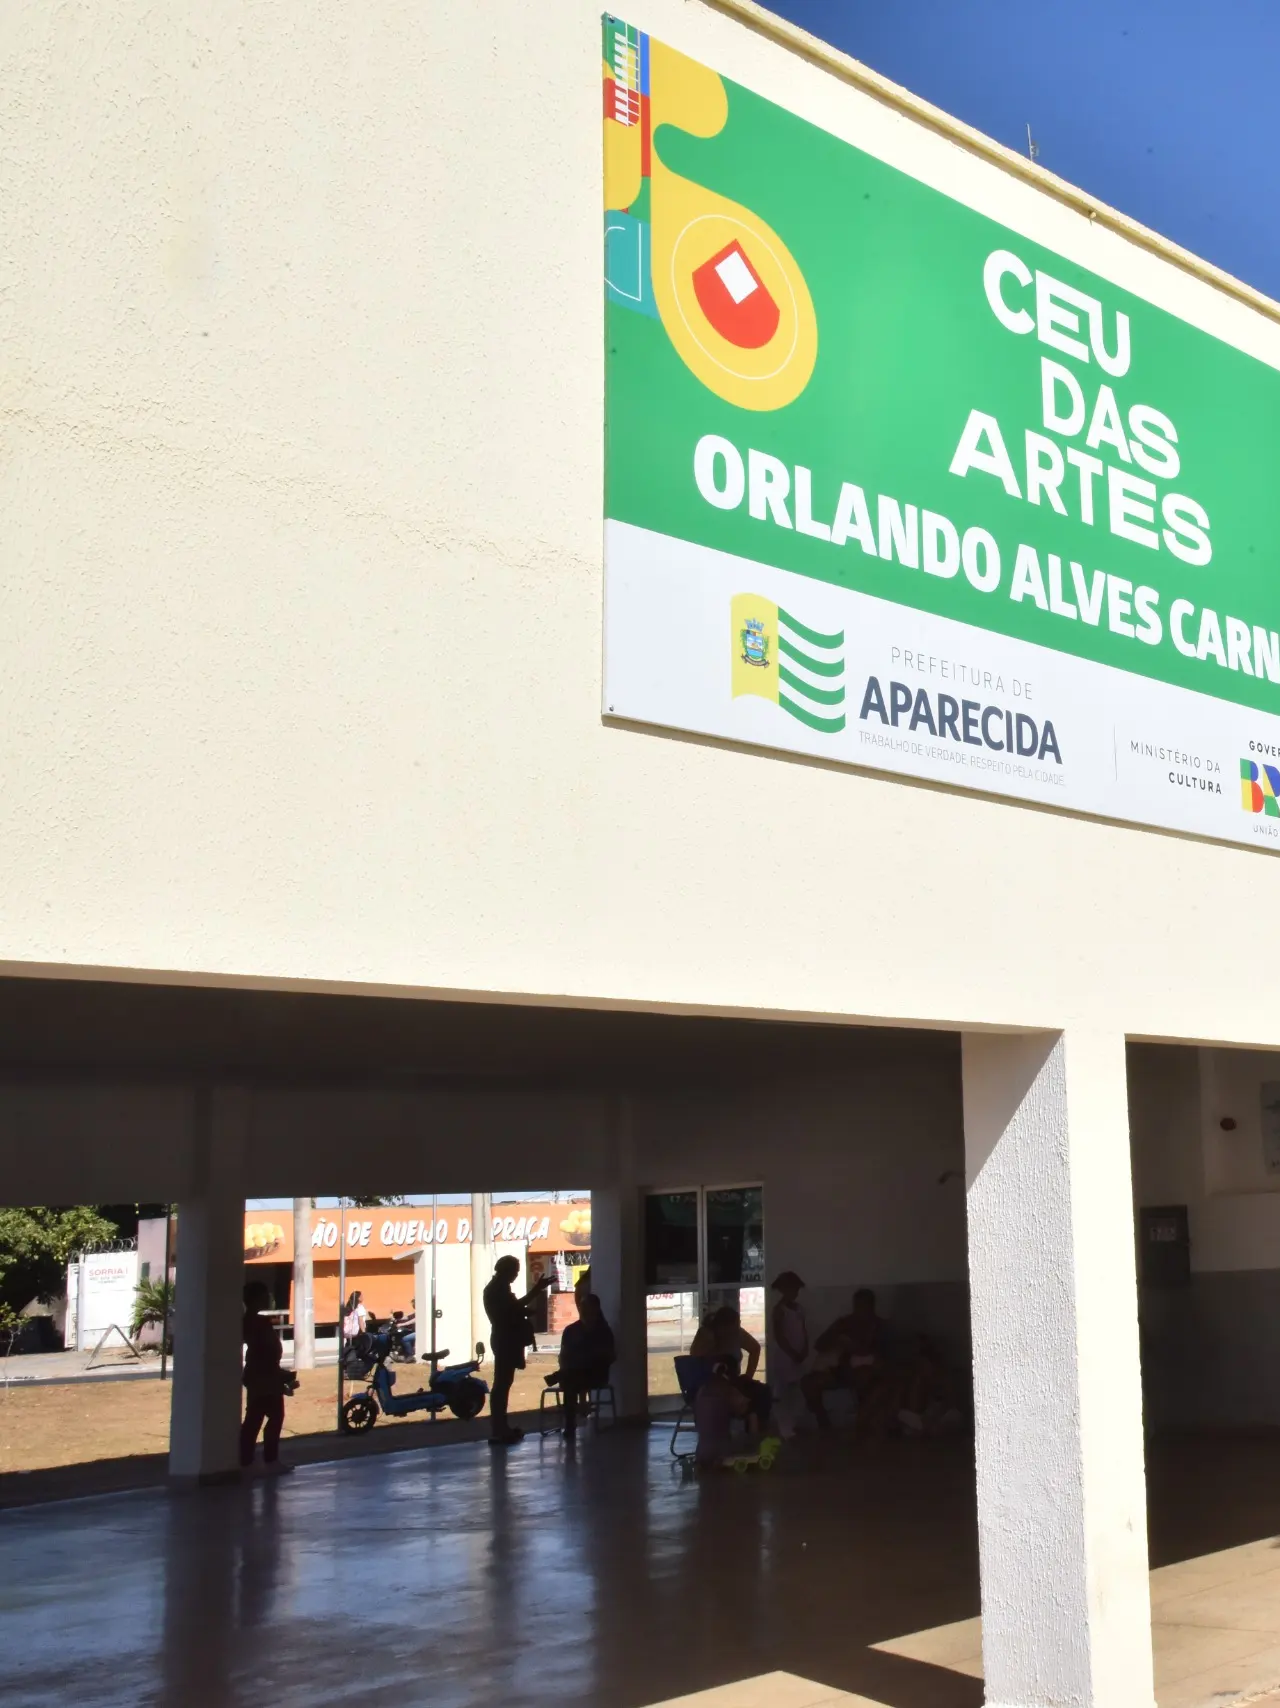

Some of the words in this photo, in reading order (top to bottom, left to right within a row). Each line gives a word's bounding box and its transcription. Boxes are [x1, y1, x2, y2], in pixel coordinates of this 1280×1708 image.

[984, 250, 1131, 378] CEU
[1041, 357, 1181, 479] DAS
[949, 409, 1213, 566] ARTES
[694, 435, 1001, 592] ORLANDO
[1009, 544, 1163, 646] ALVES
[891, 646, 1005, 693] PREFEITURA
[1012, 678, 1033, 700] DE
[859, 675, 1063, 765] APARECIDA
[859, 731, 910, 753] TRABALHO
[911, 742, 924, 756] DE
[970, 756, 1011, 775] RESPEITO
[1013, 765, 1034, 779] PELA
[1130, 740, 1201, 769] MINISTÉRIO
[1206, 760, 1221, 774] DA
[1168, 771, 1222, 795] CULTURA
[1253, 824, 1279, 838] UNIÃO
[311, 1217, 338, 1248] ÃO
[346, 1221, 372, 1247] DE
[380, 1220, 448, 1247] QUEIJO
[456, 1218, 473, 1243] D
[490, 1216, 550, 1247] PRAÇA
